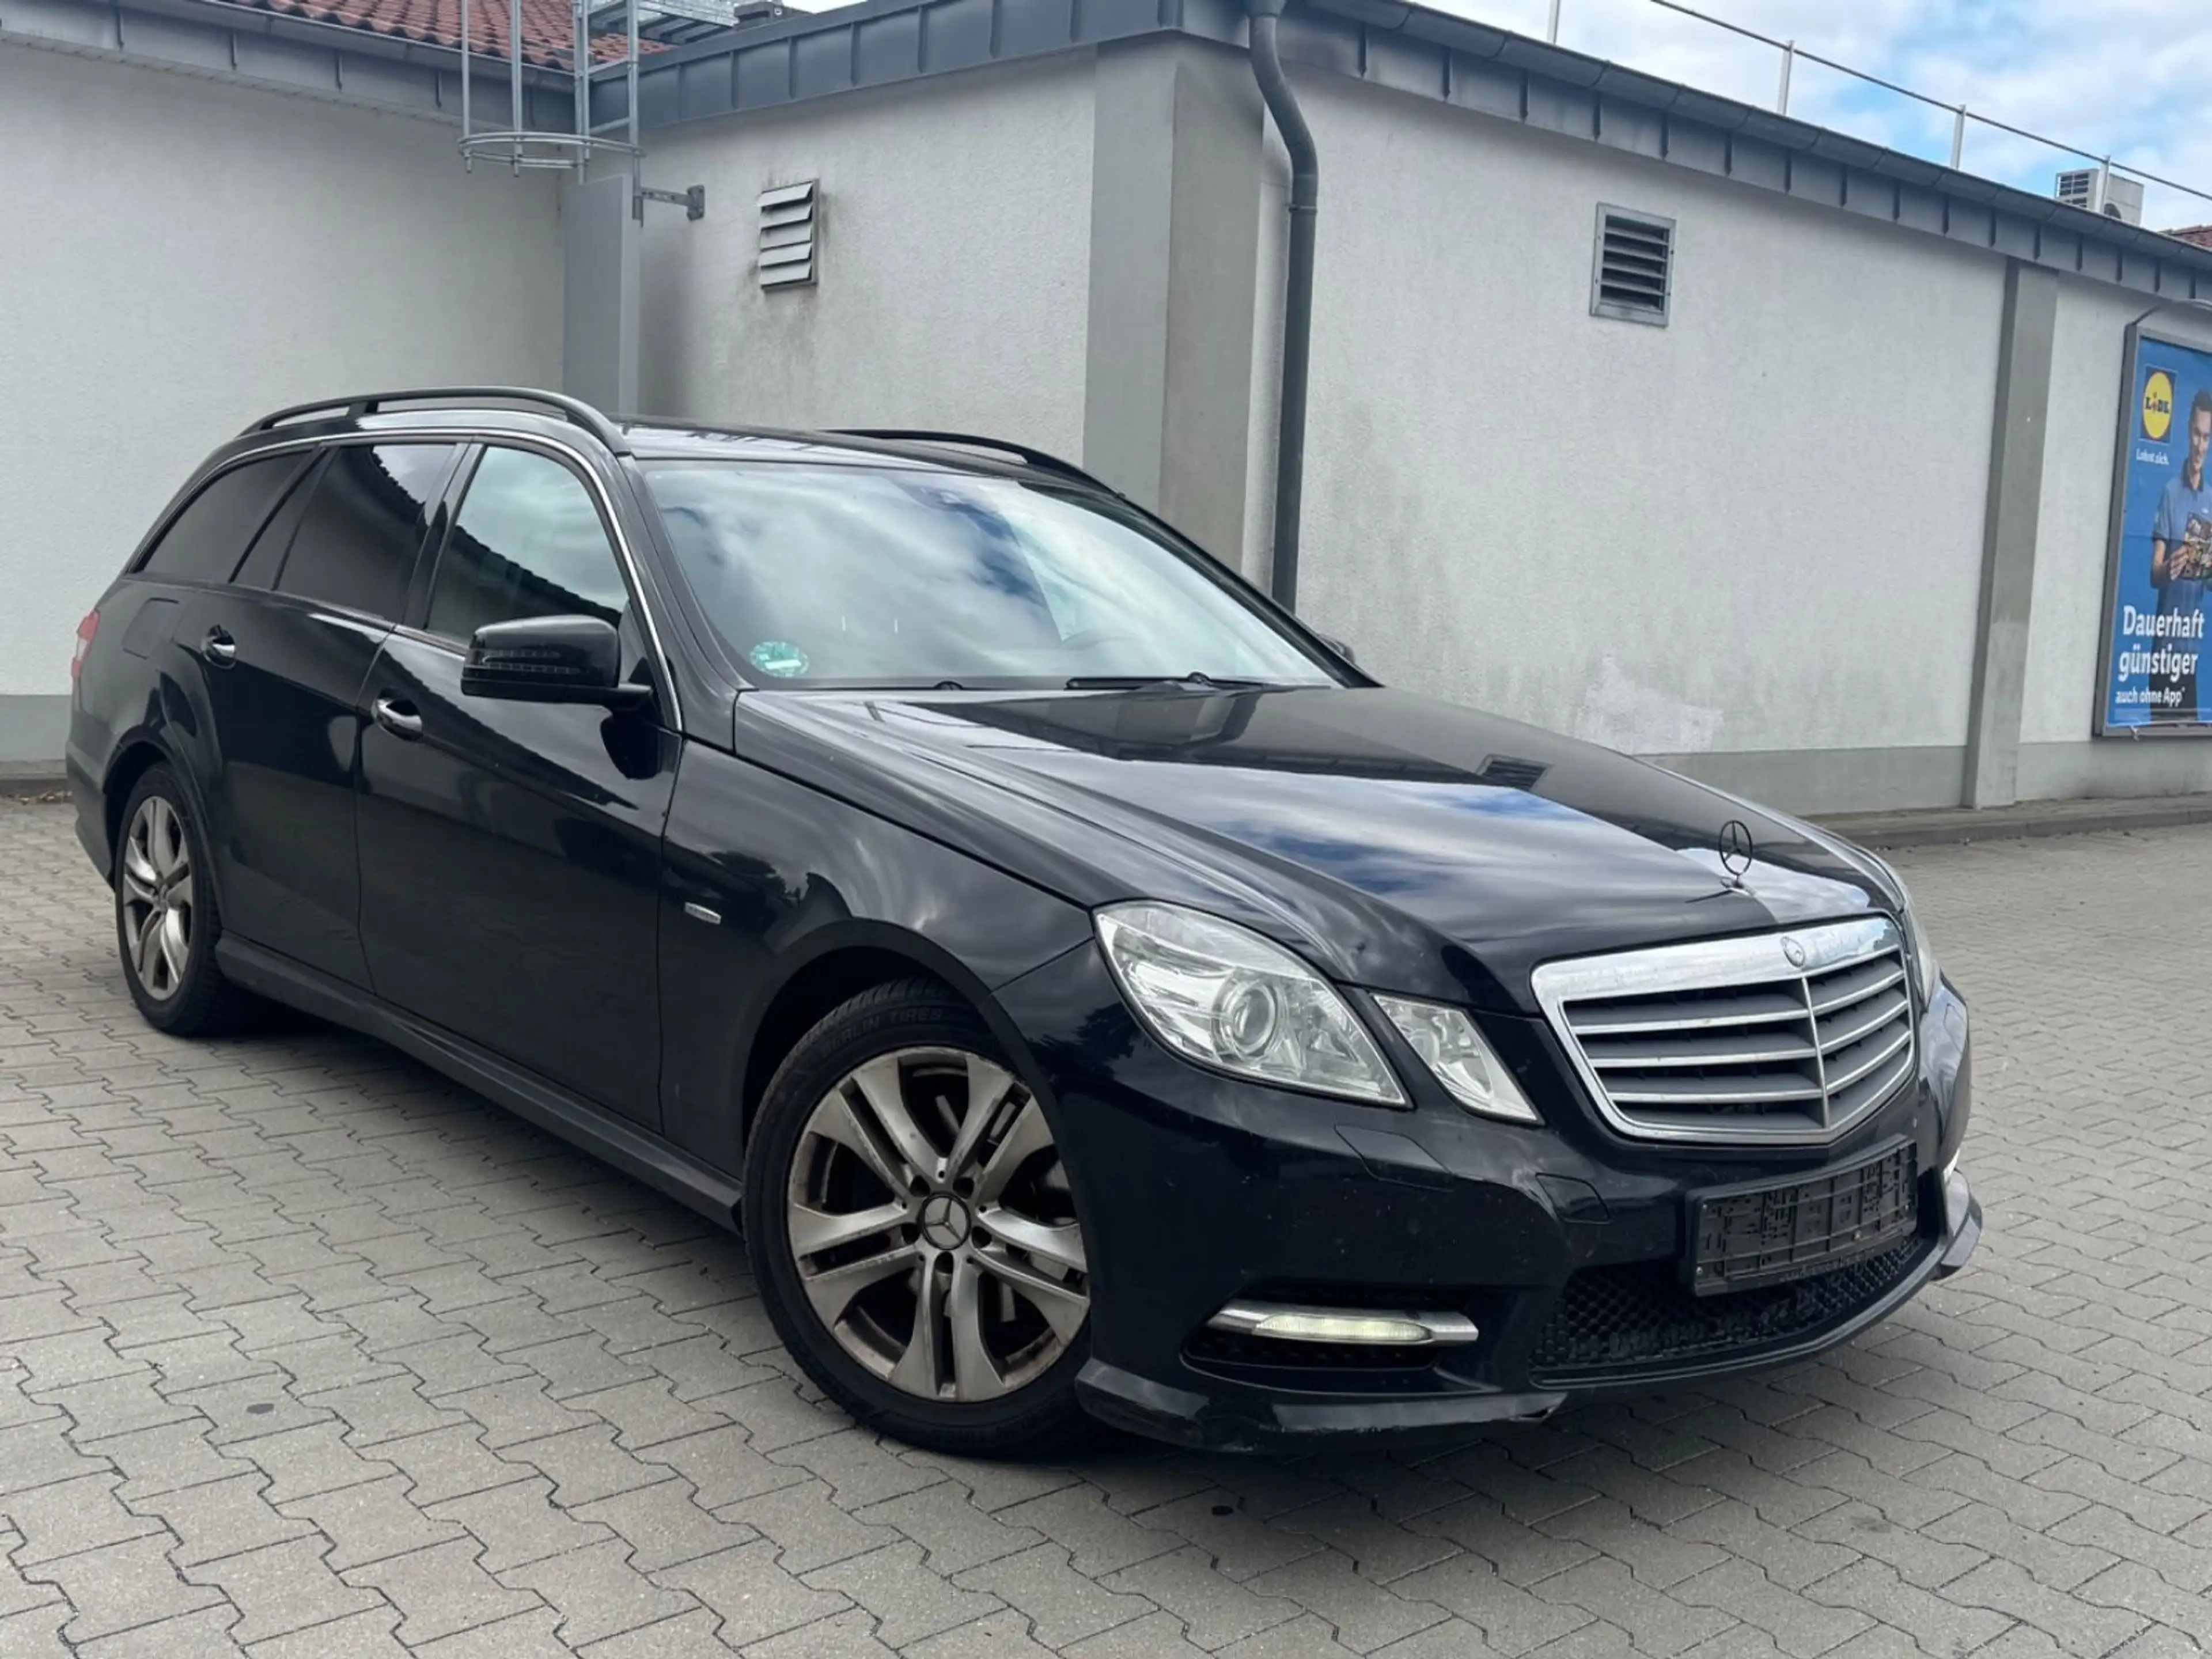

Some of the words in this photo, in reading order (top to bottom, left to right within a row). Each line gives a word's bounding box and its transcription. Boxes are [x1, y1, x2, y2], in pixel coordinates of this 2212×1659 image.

[2123, 605, 2205, 639] Dauerhaft
[2118, 643, 2198, 682] günstiger
[2115, 686, 2138, 703] auch
[2139, 686, 2162, 703] ohne
[889, 1007, 943, 1024] TIRES
